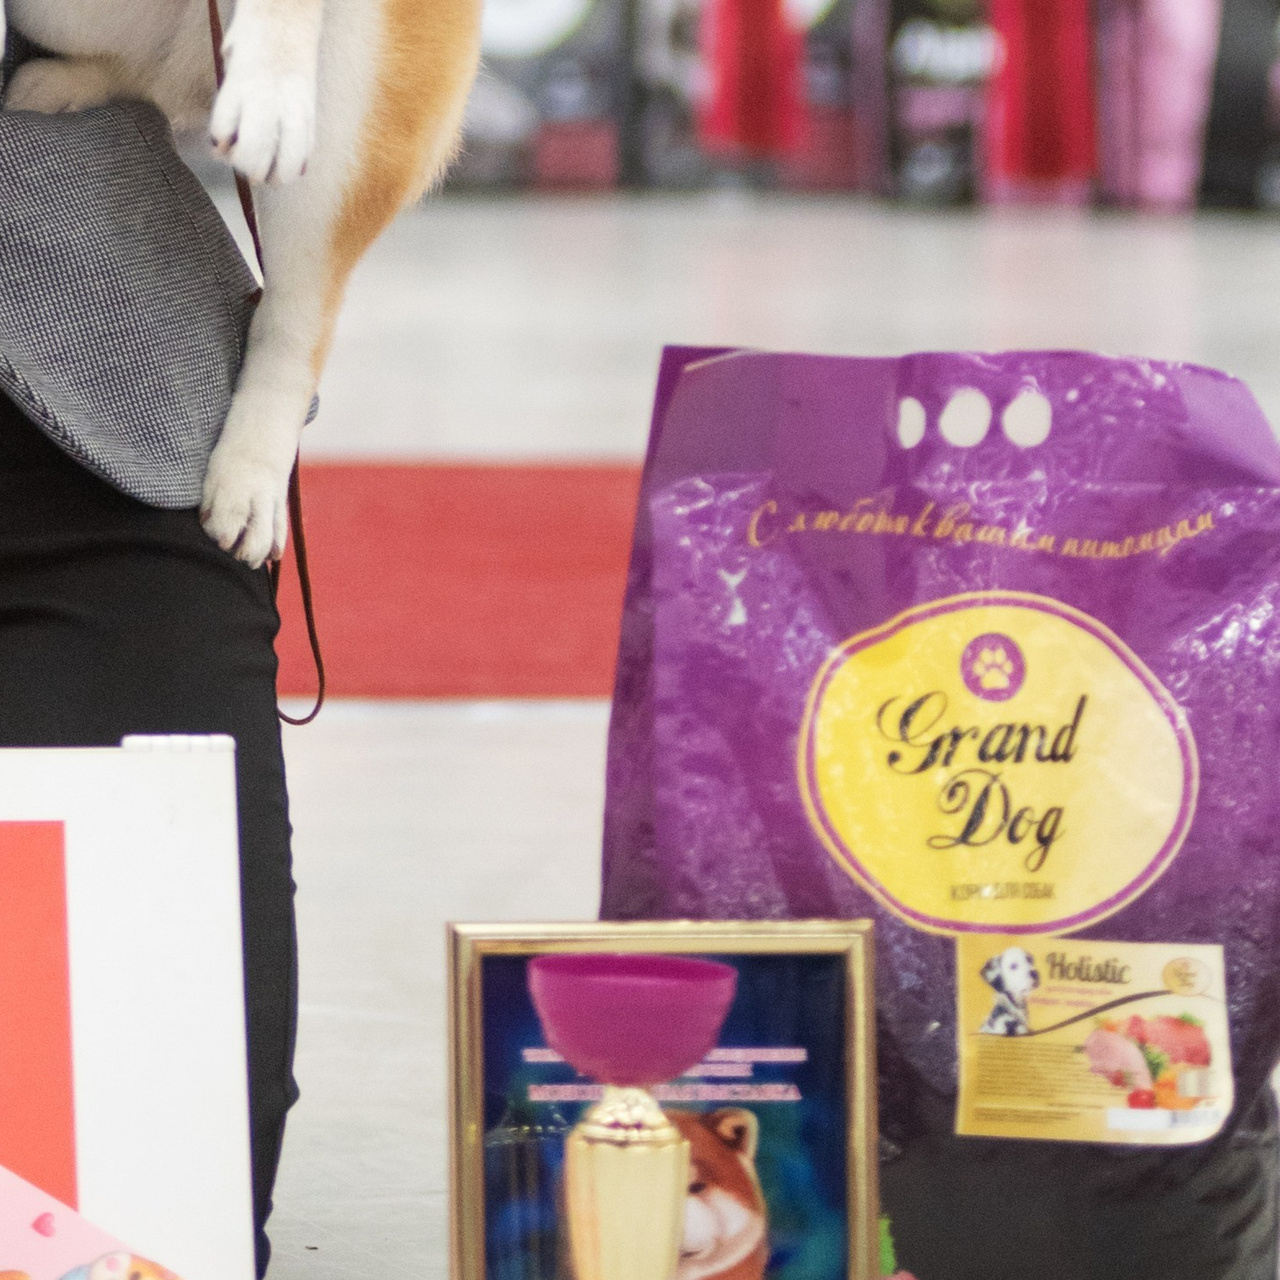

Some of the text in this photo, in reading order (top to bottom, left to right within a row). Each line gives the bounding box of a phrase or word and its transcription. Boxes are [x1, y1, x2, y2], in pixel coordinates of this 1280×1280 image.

[876, 690, 1088, 775] Grand
[926, 768, 1065, 872] Dog
[1046, 951, 1132, 984] Holistic
